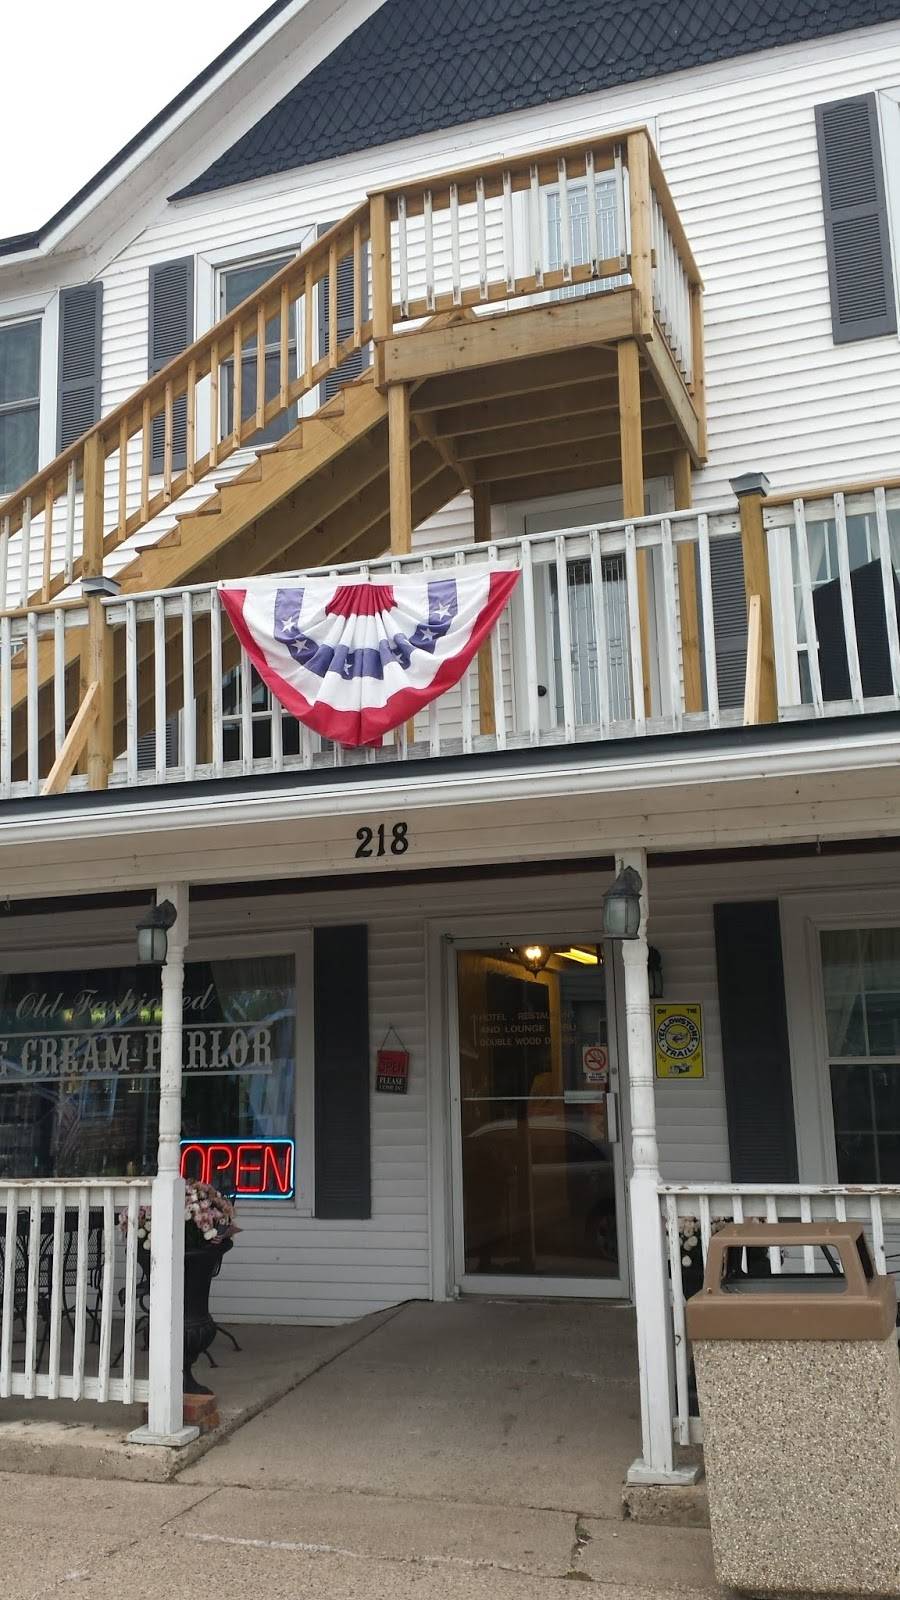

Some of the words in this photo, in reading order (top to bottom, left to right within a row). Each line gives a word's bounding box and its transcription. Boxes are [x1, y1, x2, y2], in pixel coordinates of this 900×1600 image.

[355, 822, 409, 858] 218
[16, 991, 64, 1019] Old
[72, 983, 215, 1017] Fashioed
[480, 1038, 512, 1047] DOUBLE
[516, 1036, 542, 1046] WOOD
[481, 1024, 500, 1034] AND
[505, 1023, 545, 1033] LOUNGE
[659, 1017, 698, 1042] YELLOWSTONE
[20, 1033, 131, 1077] CREAM
[144, 1028, 273, 1070] PRLOR
[665, 1046, 693, 1057] TRAIL
[179, 1143, 292, 1193] OPEN
